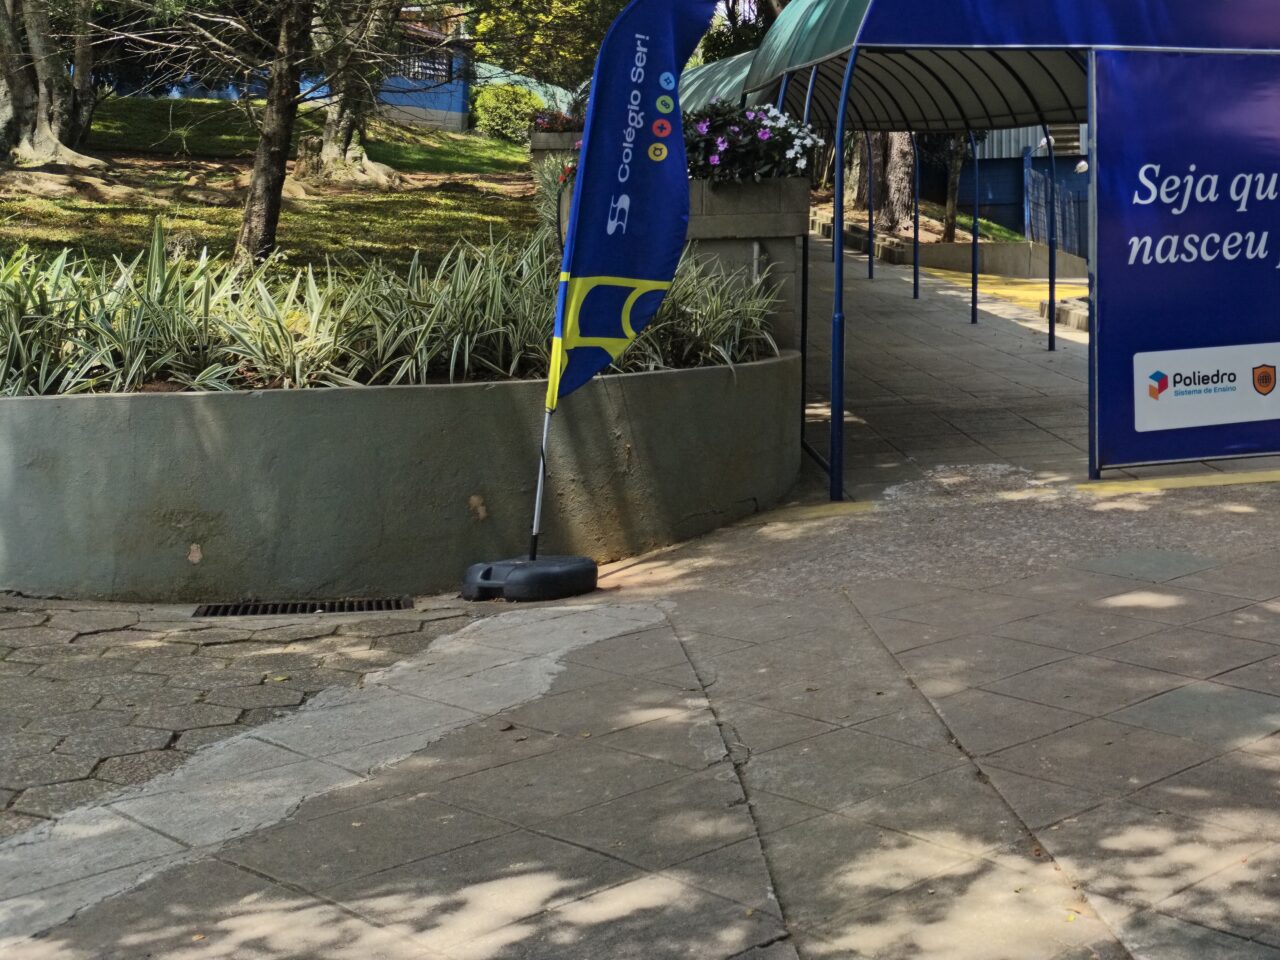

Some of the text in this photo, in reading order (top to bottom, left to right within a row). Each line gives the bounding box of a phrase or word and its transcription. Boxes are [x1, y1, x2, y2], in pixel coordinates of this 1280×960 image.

[618, 88, 644, 183] Colégio
[631, 33, 650, 84] Ser!
[1132, 163, 1221, 215] Seja
[1127, 229, 1269, 266] nasceu
[1173, 369, 1237, 387] Poliedro
[1174, 388, 1202, 397] Sistema
[1213, 385, 1237, 394] Ensino
